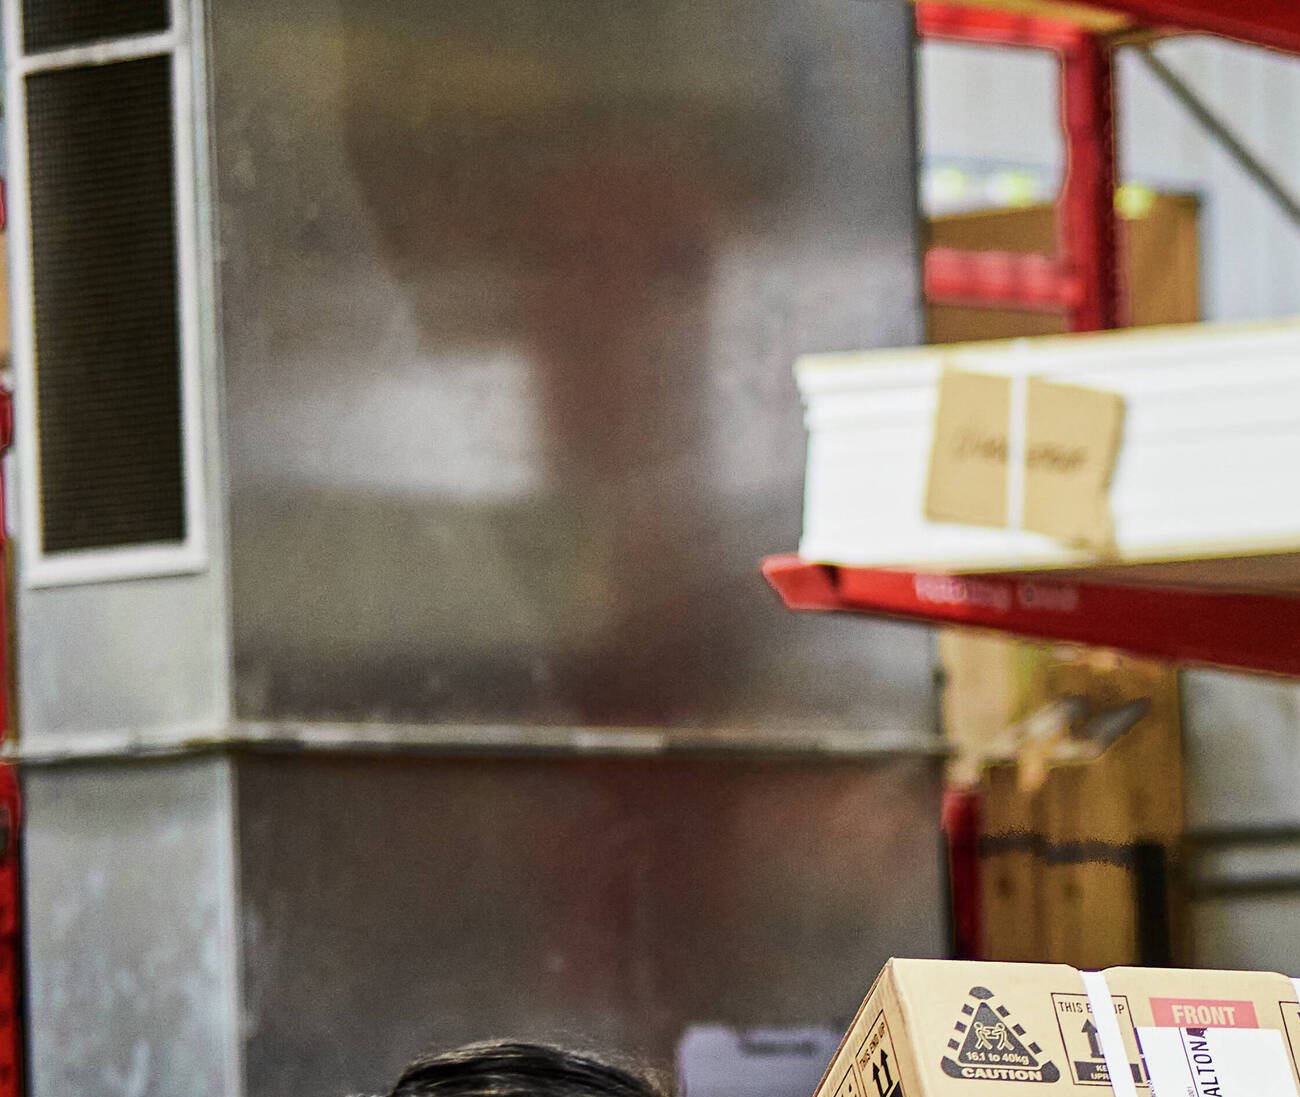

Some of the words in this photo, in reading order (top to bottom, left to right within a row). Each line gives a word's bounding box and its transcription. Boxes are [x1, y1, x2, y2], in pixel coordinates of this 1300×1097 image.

[1058, 1001, 1083, 1013] THIS
[1171, 1004, 1236, 1025] FRONT
[988, 1053, 1000, 1062] to
[1002, 1053, 1029, 1065] 40kg
[1184, 1027, 1222, 1097] ALTONA
[961, 1067, 1042, 1081] CAUTION
